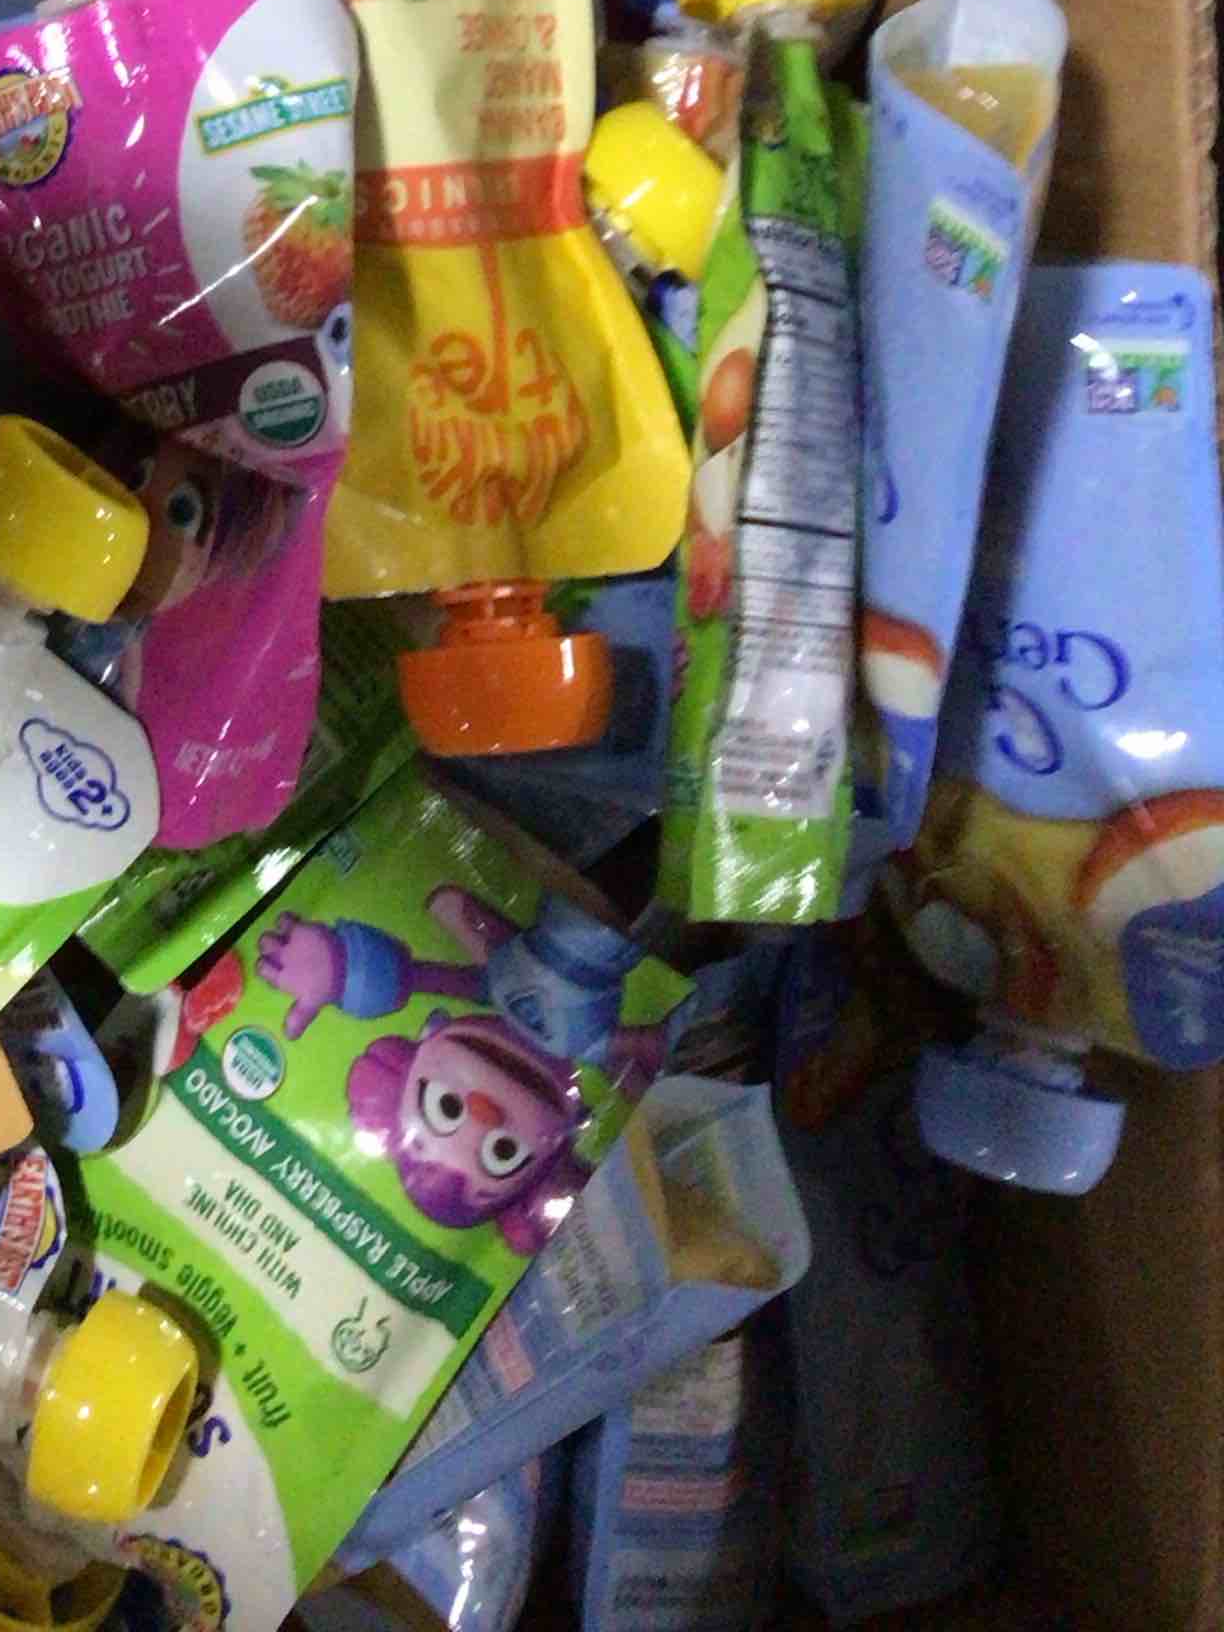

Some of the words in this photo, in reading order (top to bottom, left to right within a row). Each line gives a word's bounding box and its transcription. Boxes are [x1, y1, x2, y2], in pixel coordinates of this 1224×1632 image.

[44, 245, 152, 298] YOGURT
[251, 371, 305, 406] USDA
[40, 750, 74, 789] ages
[52, 745, 88, 782] kids
[231, 1056, 267, 1090] USDA
[185, 1069, 278, 1157] AVOCADO
[186, 1184, 258, 1254] CHOLINE
[221, 1180, 260, 1220] DHA
[273, 1155, 382, 1261] RASPBERRY
[257, 1214, 300, 1254] AND
[252, 1251, 301, 1297] WITH
[387, 1251, 453, 1303] APPLE
[179, 1264, 237, 1336] veggie
[243, 1360, 290, 1427] fruit
